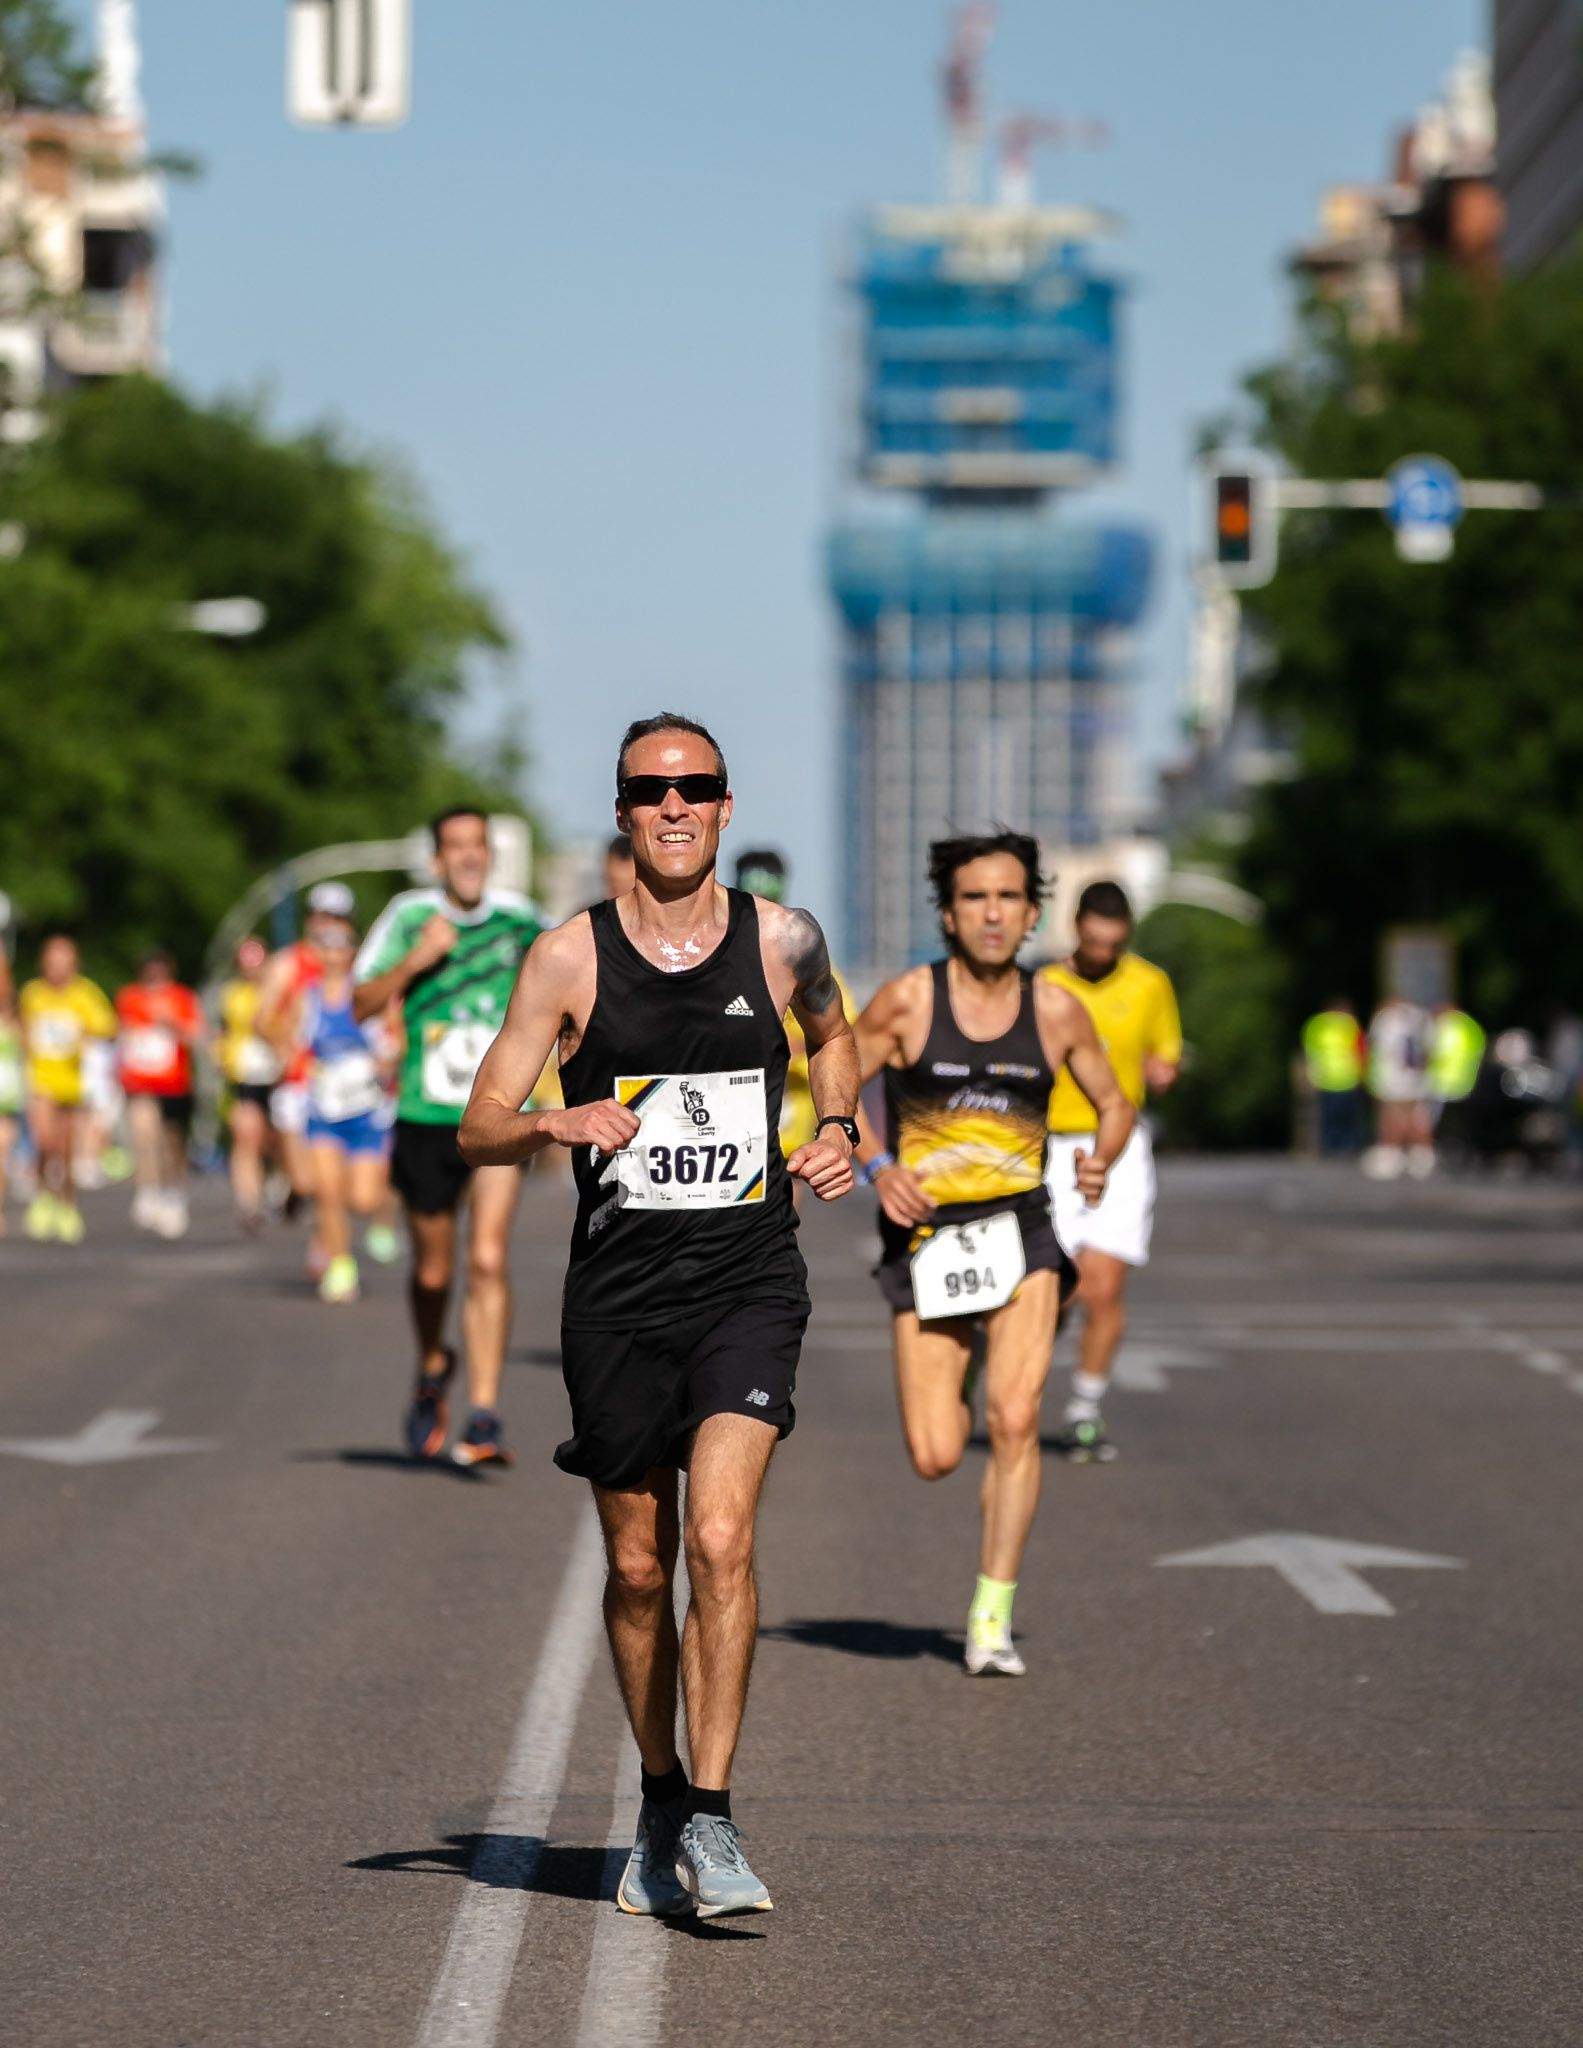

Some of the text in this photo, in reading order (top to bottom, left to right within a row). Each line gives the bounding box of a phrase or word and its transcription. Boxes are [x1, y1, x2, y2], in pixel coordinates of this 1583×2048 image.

[724, 1008, 755, 1017] adidas
[695, 1112, 707, 1123] 13
[648, 1143, 740, 1185] 3672
